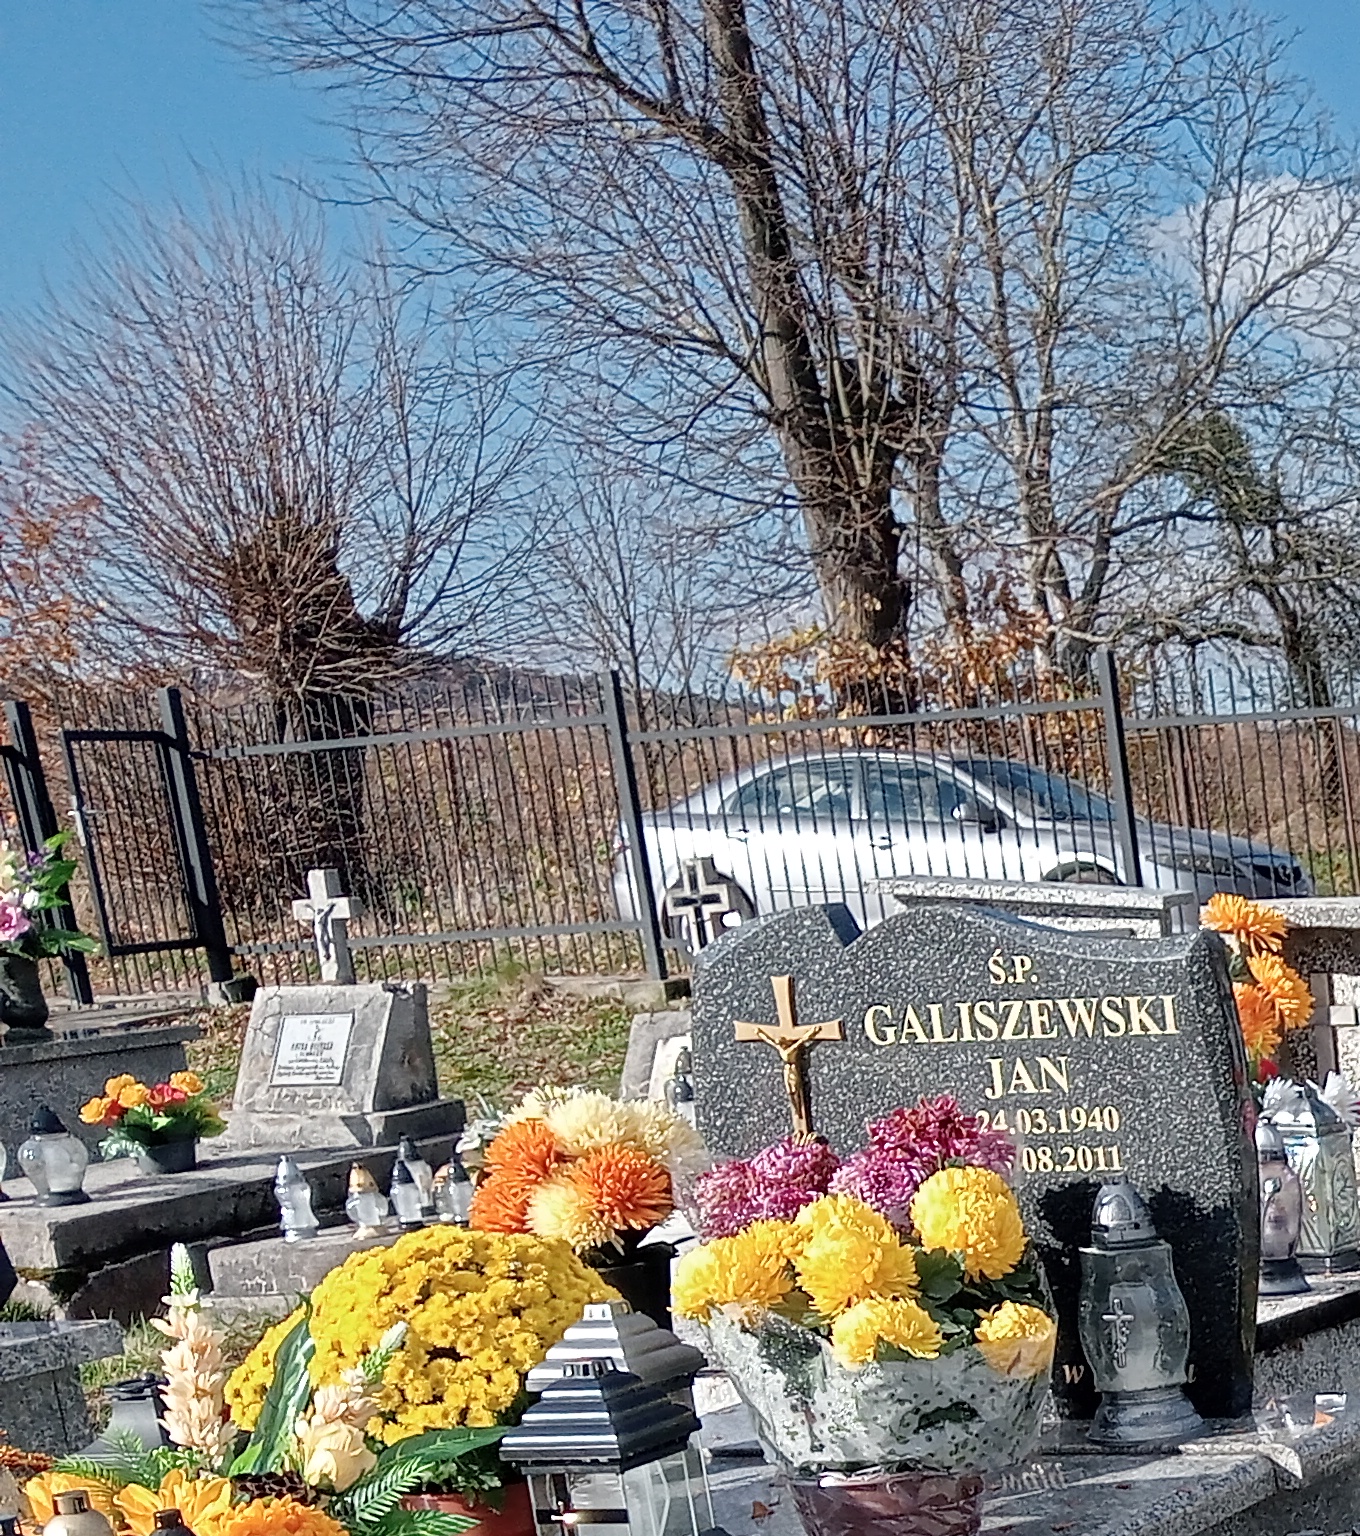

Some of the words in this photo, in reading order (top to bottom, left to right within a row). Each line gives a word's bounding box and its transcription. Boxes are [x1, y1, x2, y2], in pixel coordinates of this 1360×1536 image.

[987, 949, 1038, 985] Ś.P.
[863, 994, 1180, 1046] GALISZEWSKI
[985, 1056, 1070, 1100] JAN
